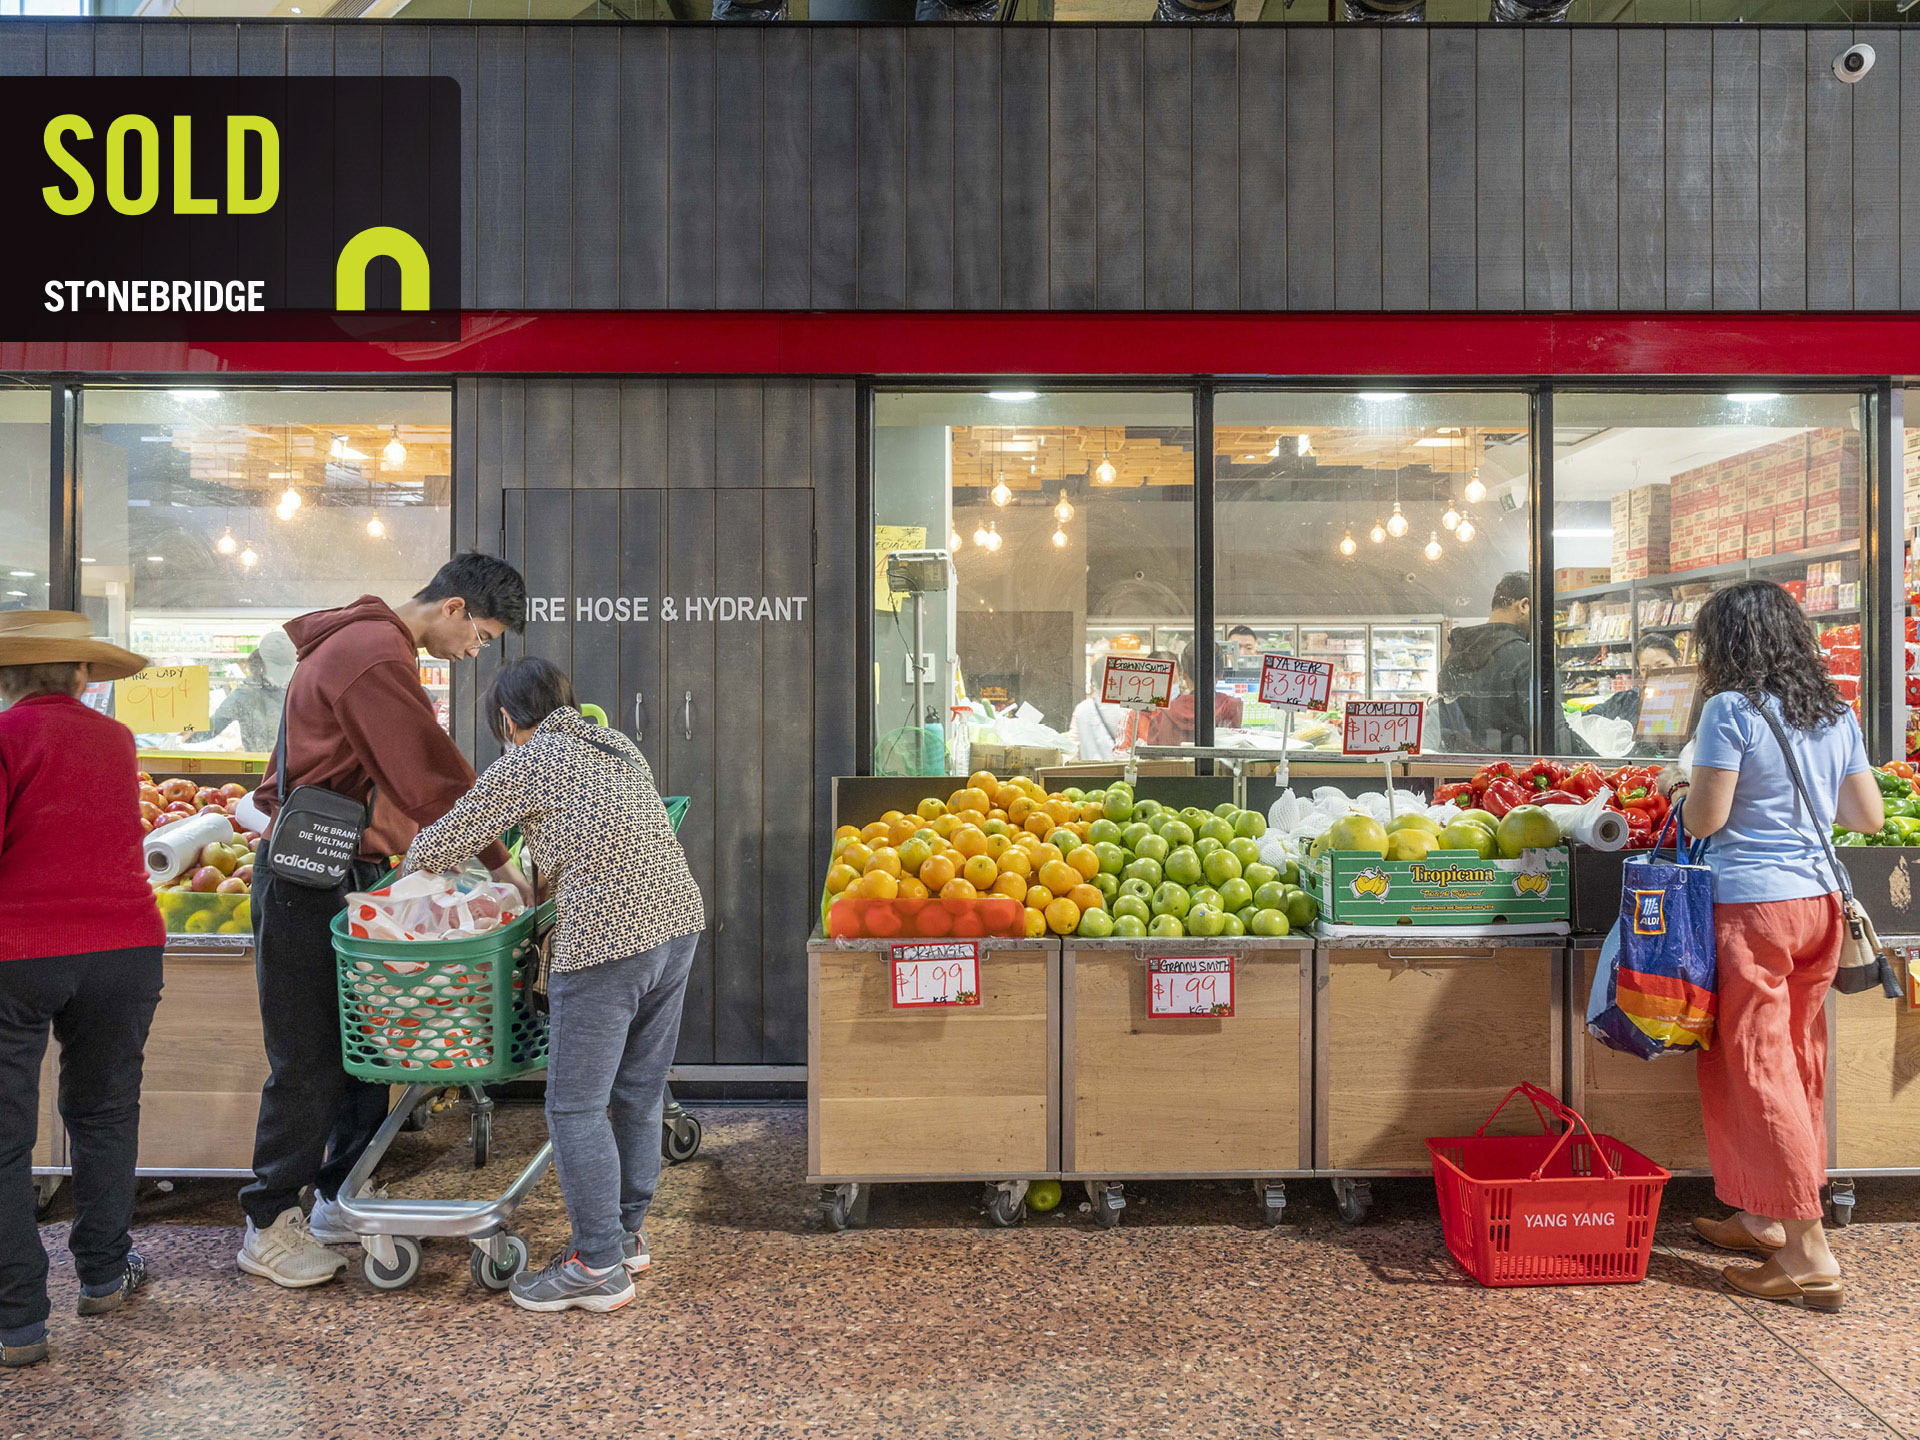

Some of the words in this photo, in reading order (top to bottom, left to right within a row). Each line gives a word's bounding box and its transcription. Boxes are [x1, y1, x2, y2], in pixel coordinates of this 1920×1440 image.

[526, 598, 566, 622] IRE
[576, 597, 649, 622] HOSE
[660, 597, 679, 622] &
[685, 596, 808, 622] HYDRANT
[1275, 657, 1290, 671] YA
[1294, 660, 1327, 675] PEAR
[123, 672, 149, 681] INK
[1264, 671, 1317, 701] $3.99
[1347, 716, 1409, 744] $12.99
[298, 830, 313, 840] DIE
[312, 823, 330, 834] THE
[316, 846, 328, 856] LA
[273, 853, 325, 873] adidas
[1410, 863, 1496, 887] Tropicana
[1639, 917, 1660, 926] ALDI
[896, 963, 962, 1000] $1.99
[1153, 975, 1216, 1007] $1.99
[1189, 1005, 1208, 1016] KG
[1524, 1213, 1567, 1228] YANG
[1572, 1212, 1615, 1227] YANG
